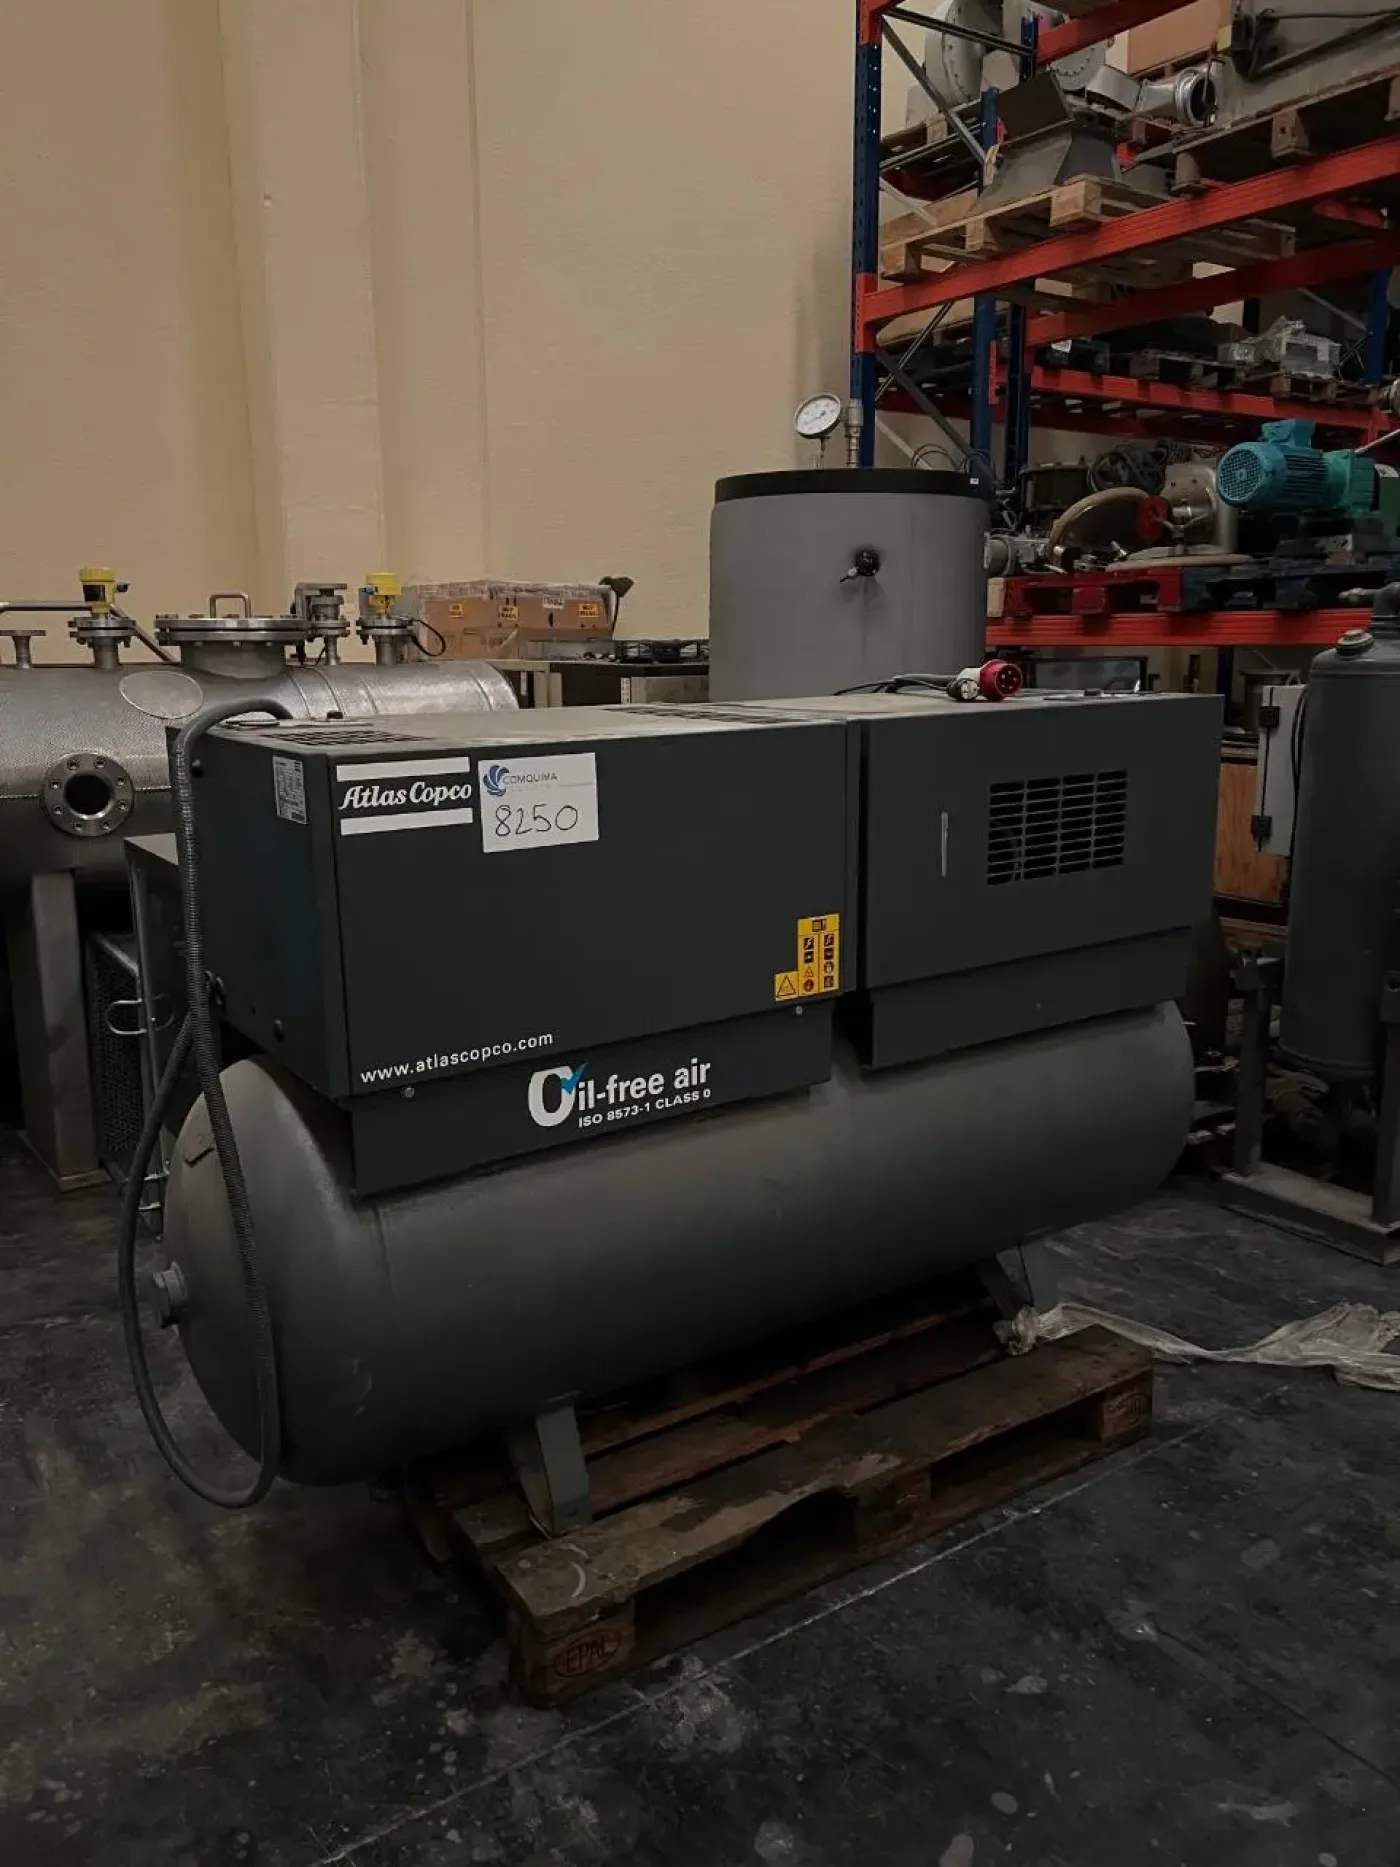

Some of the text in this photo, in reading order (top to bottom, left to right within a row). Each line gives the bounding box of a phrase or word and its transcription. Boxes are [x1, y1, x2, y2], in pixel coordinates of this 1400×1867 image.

[338, 781, 472, 810] Atlas Copco
[503, 772, 557, 785] COMQUIMA
[496, 803, 578, 836] 8250
[360, 1033, 554, 1083] www.atlascopco.com
[528, 1057, 711, 1127] Oil-free air
[578, 1088, 711, 1128] ISO 8573-1 CLASS 0
